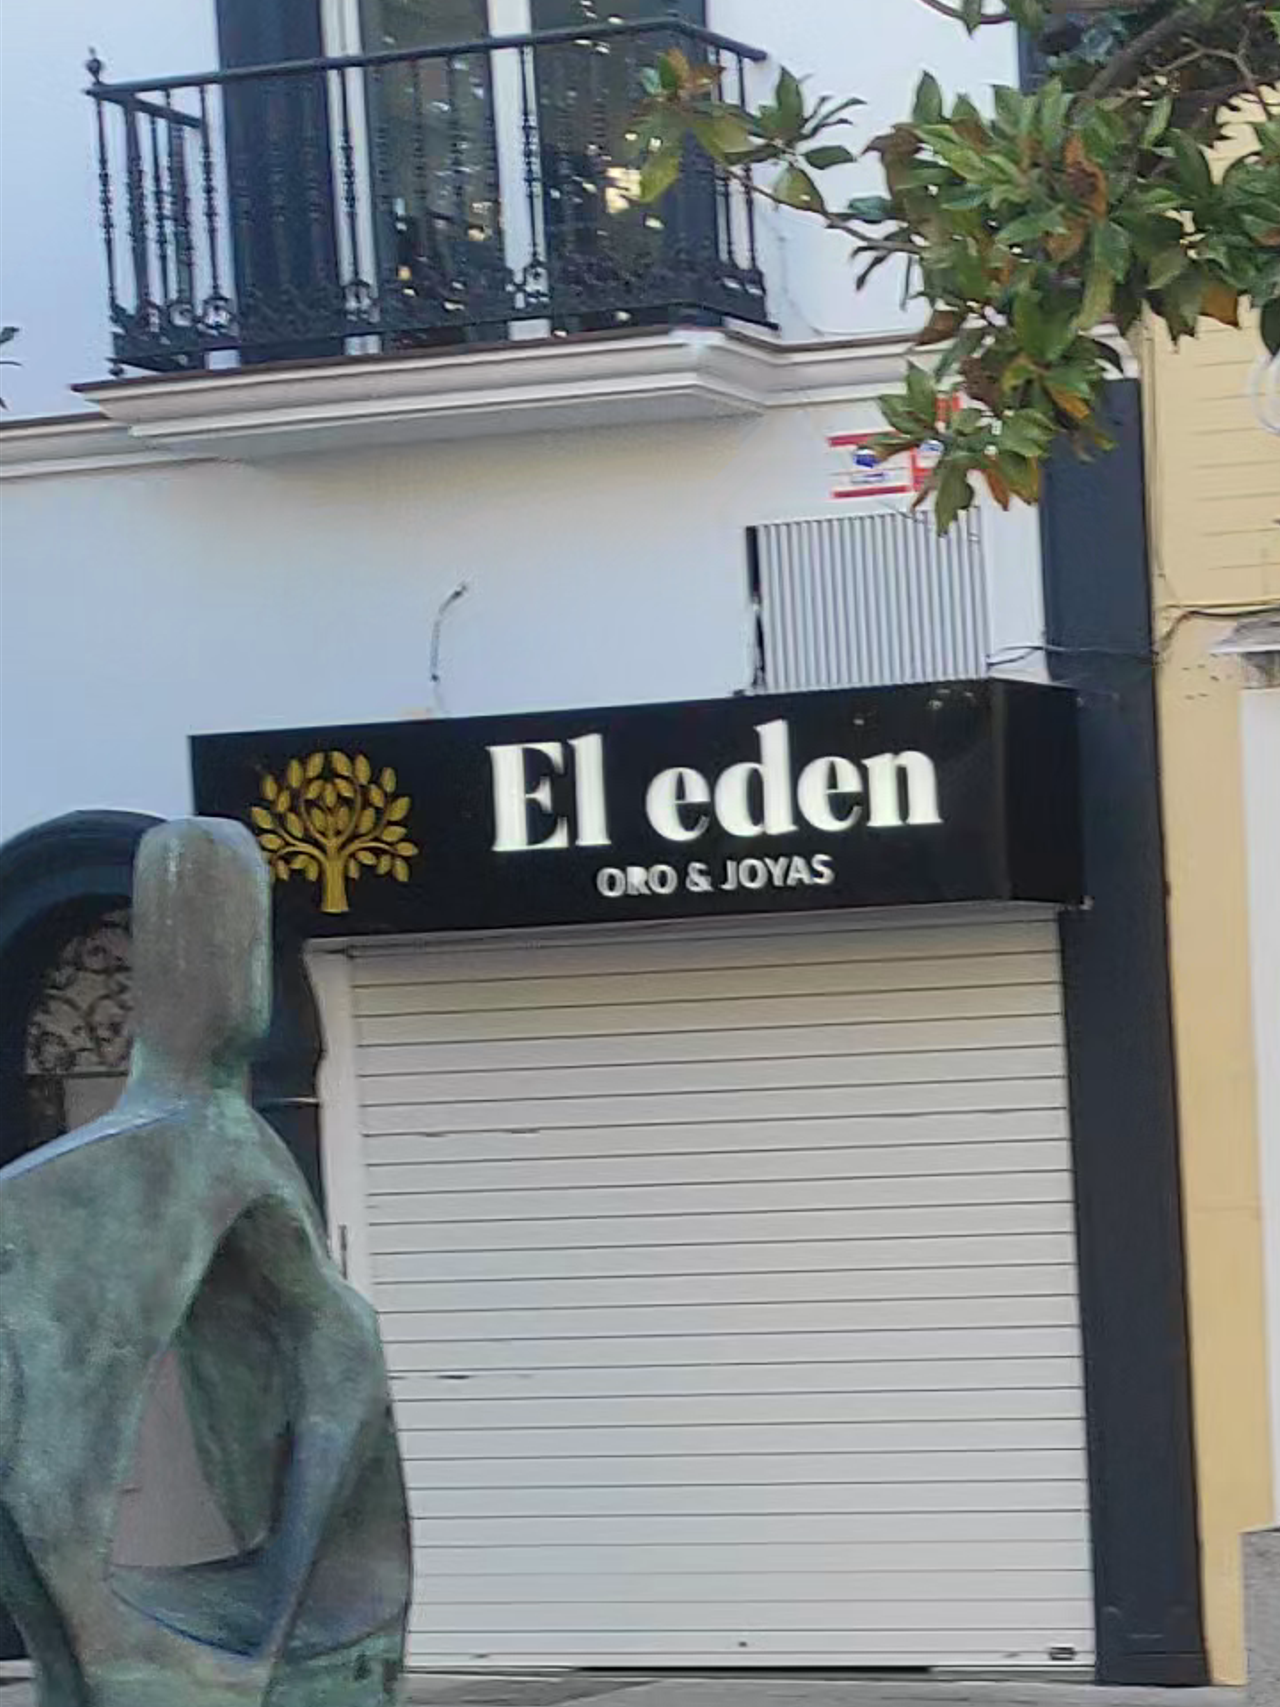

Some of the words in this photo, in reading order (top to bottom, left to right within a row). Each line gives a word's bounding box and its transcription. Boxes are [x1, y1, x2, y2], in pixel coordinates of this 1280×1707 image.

[486, 733, 612, 852] El
[646, 719, 943, 842] eden
[596, 862, 678, 897] ORO
[685, 862, 714, 893] &
[719, 853, 835, 892] JOYAS
